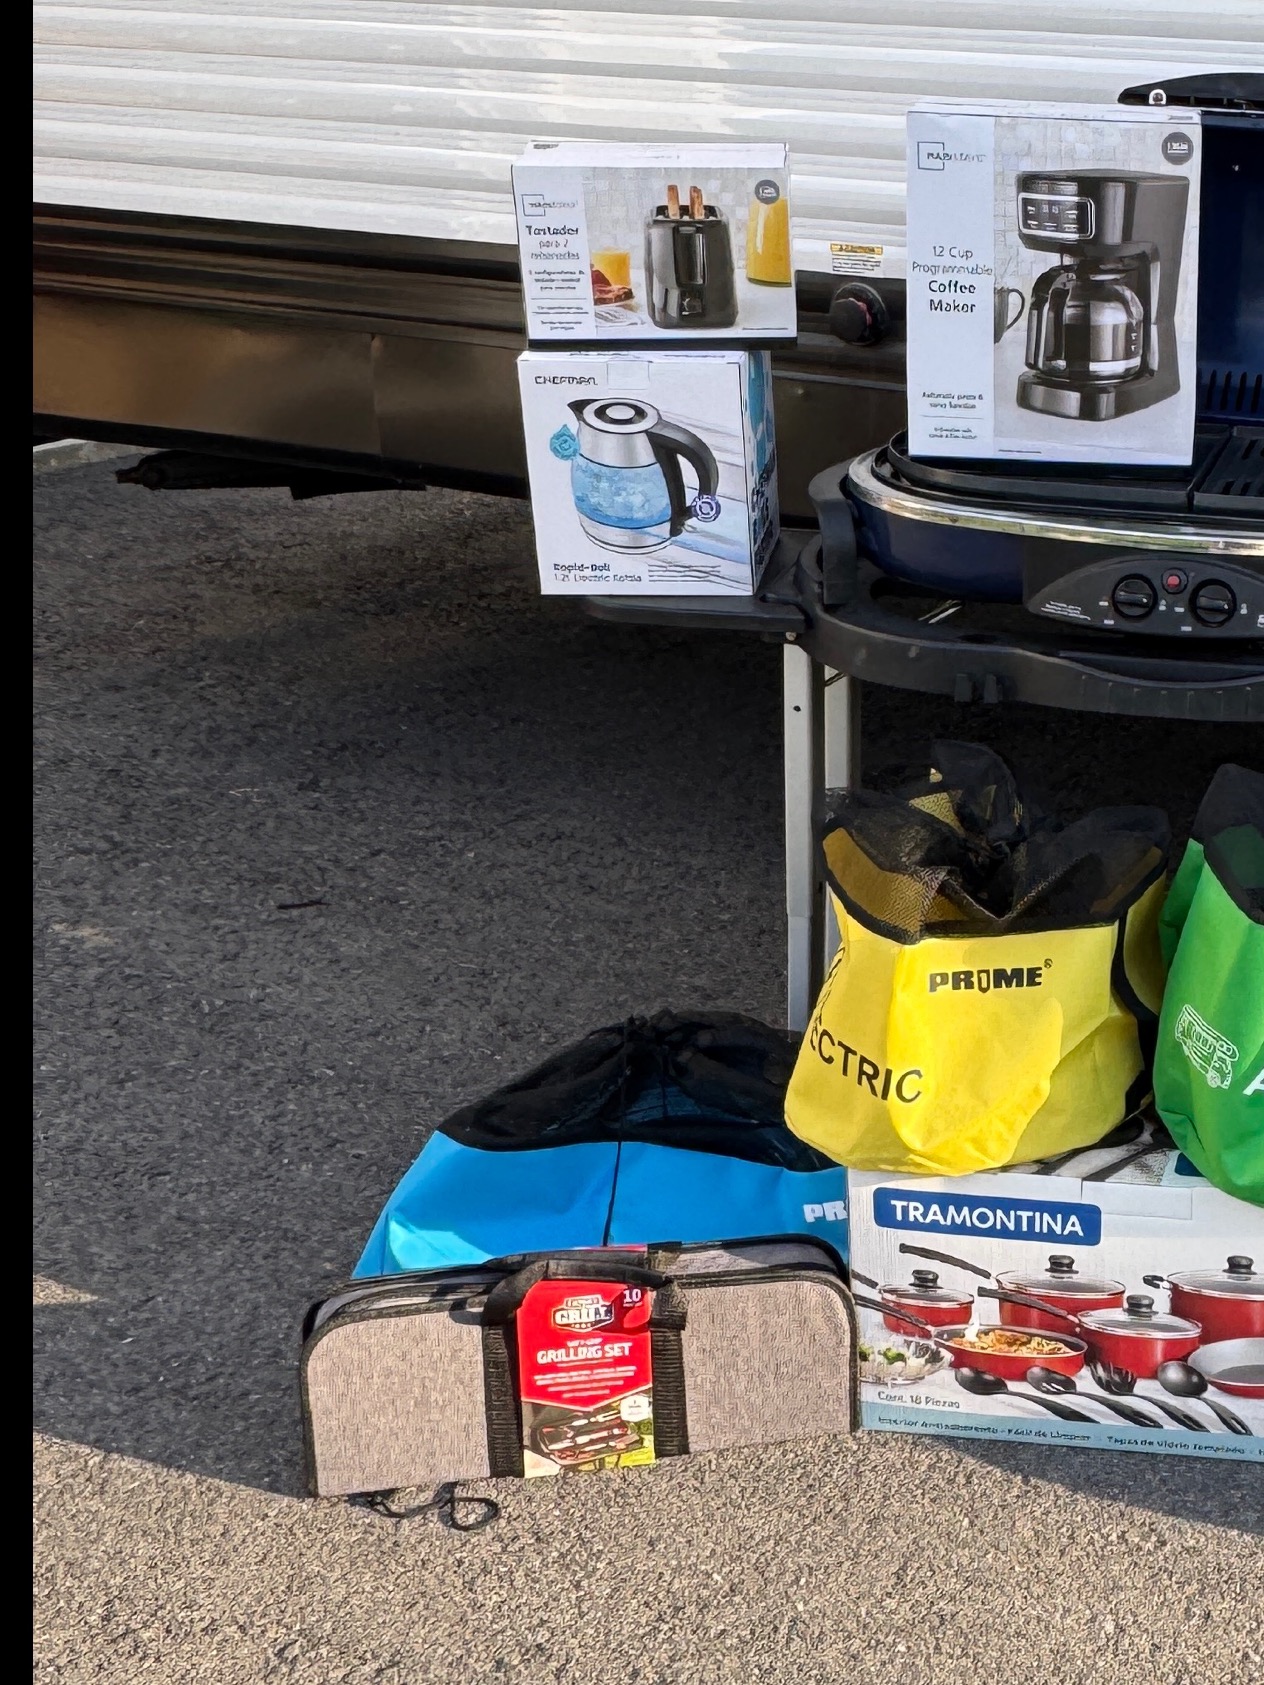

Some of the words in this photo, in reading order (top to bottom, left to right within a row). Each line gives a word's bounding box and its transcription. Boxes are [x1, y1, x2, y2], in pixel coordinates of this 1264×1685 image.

[933, 246, 945, 257] 12
[949, 246, 974, 260] Cup
[928, 280, 976, 294] Coffee
[929, 299, 976, 313] Maker
[890, 1200, 1084, 1236] TRAMONTINA
[623, 1288, 642, 1303] 10
[605, 1342, 633, 1357] SET
